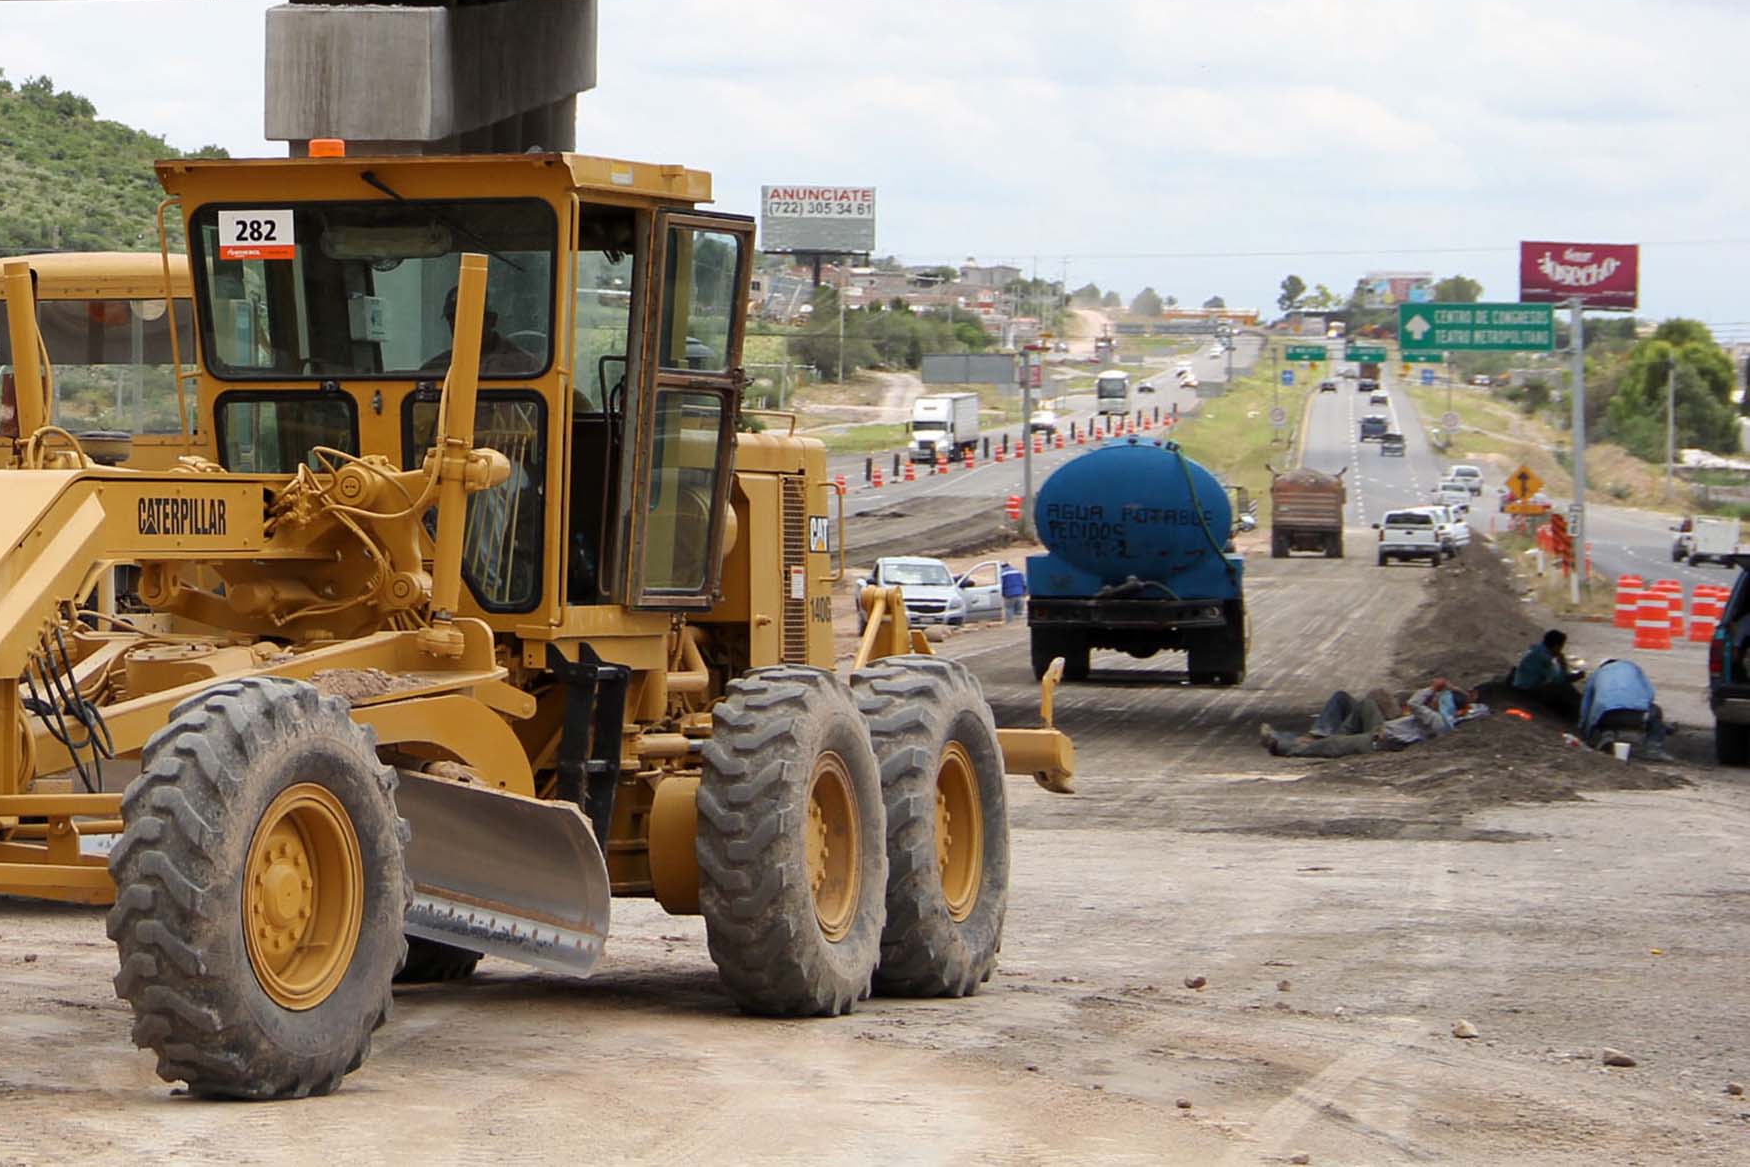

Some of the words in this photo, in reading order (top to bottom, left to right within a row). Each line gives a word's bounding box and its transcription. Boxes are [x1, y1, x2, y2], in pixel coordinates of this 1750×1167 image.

[770, 188, 872, 202] ANUNCIATE
[769, 201, 804, 216] (722)
[807, 201, 832, 215] 305
[836, 202, 852, 215] 34
[235, 220, 277, 242] 282
[1434, 310, 1472, 324] CENTRO
[1475, 310, 1489, 324] DE
[1492, 310, 1549, 324] CONGRESOS
[1434, 329, 1471, 344] TEATRO
[1473, 329, 1549, 345] METROPOLITANO
[137, 497, 227, 536] CATERPILLAR
[1047, 504, 1104, 521] AGUA
[810, 517, 829, 552] CAT
[810, 597, 832, 623] 140G
